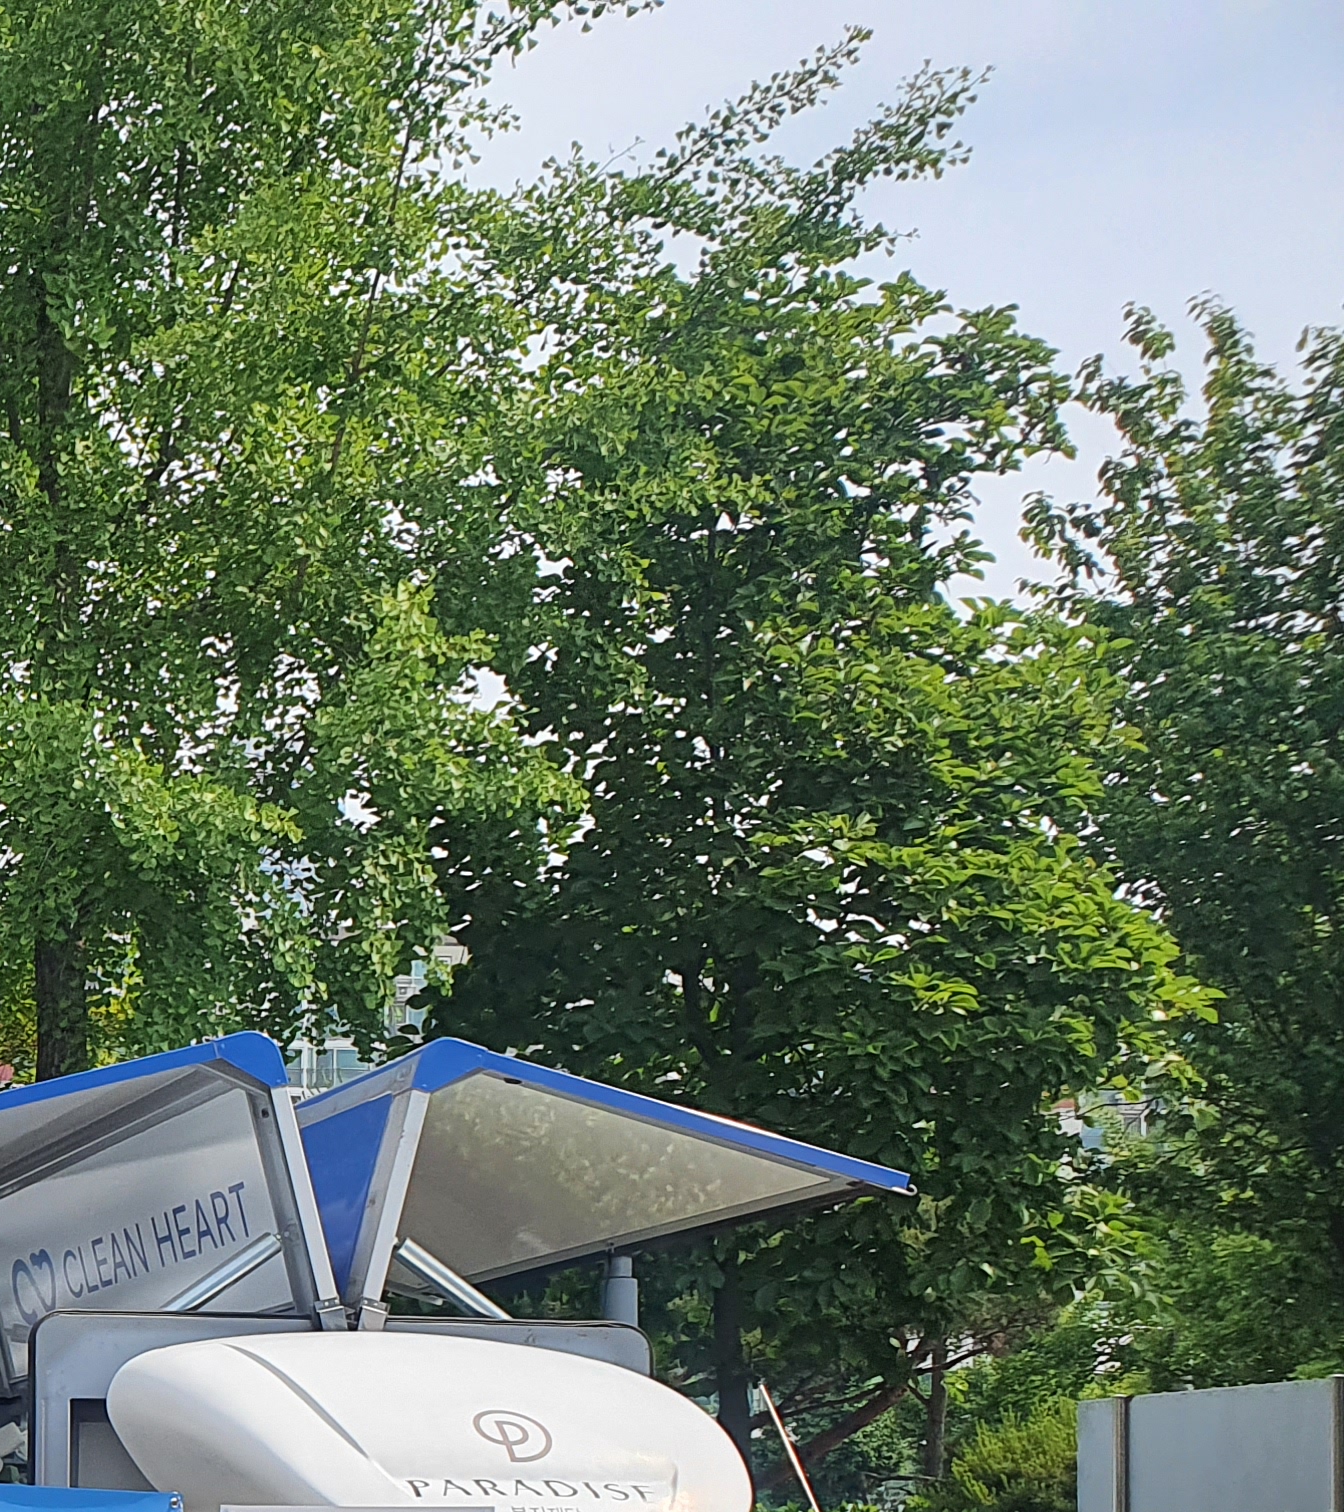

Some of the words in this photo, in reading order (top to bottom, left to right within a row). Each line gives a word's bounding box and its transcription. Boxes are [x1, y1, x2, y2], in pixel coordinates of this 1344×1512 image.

[63, 1223, 150, 1299] CLEAN
[150, 1181, 251, 1268] HEART
[405, 1479, 656, 1503] PARADISE
